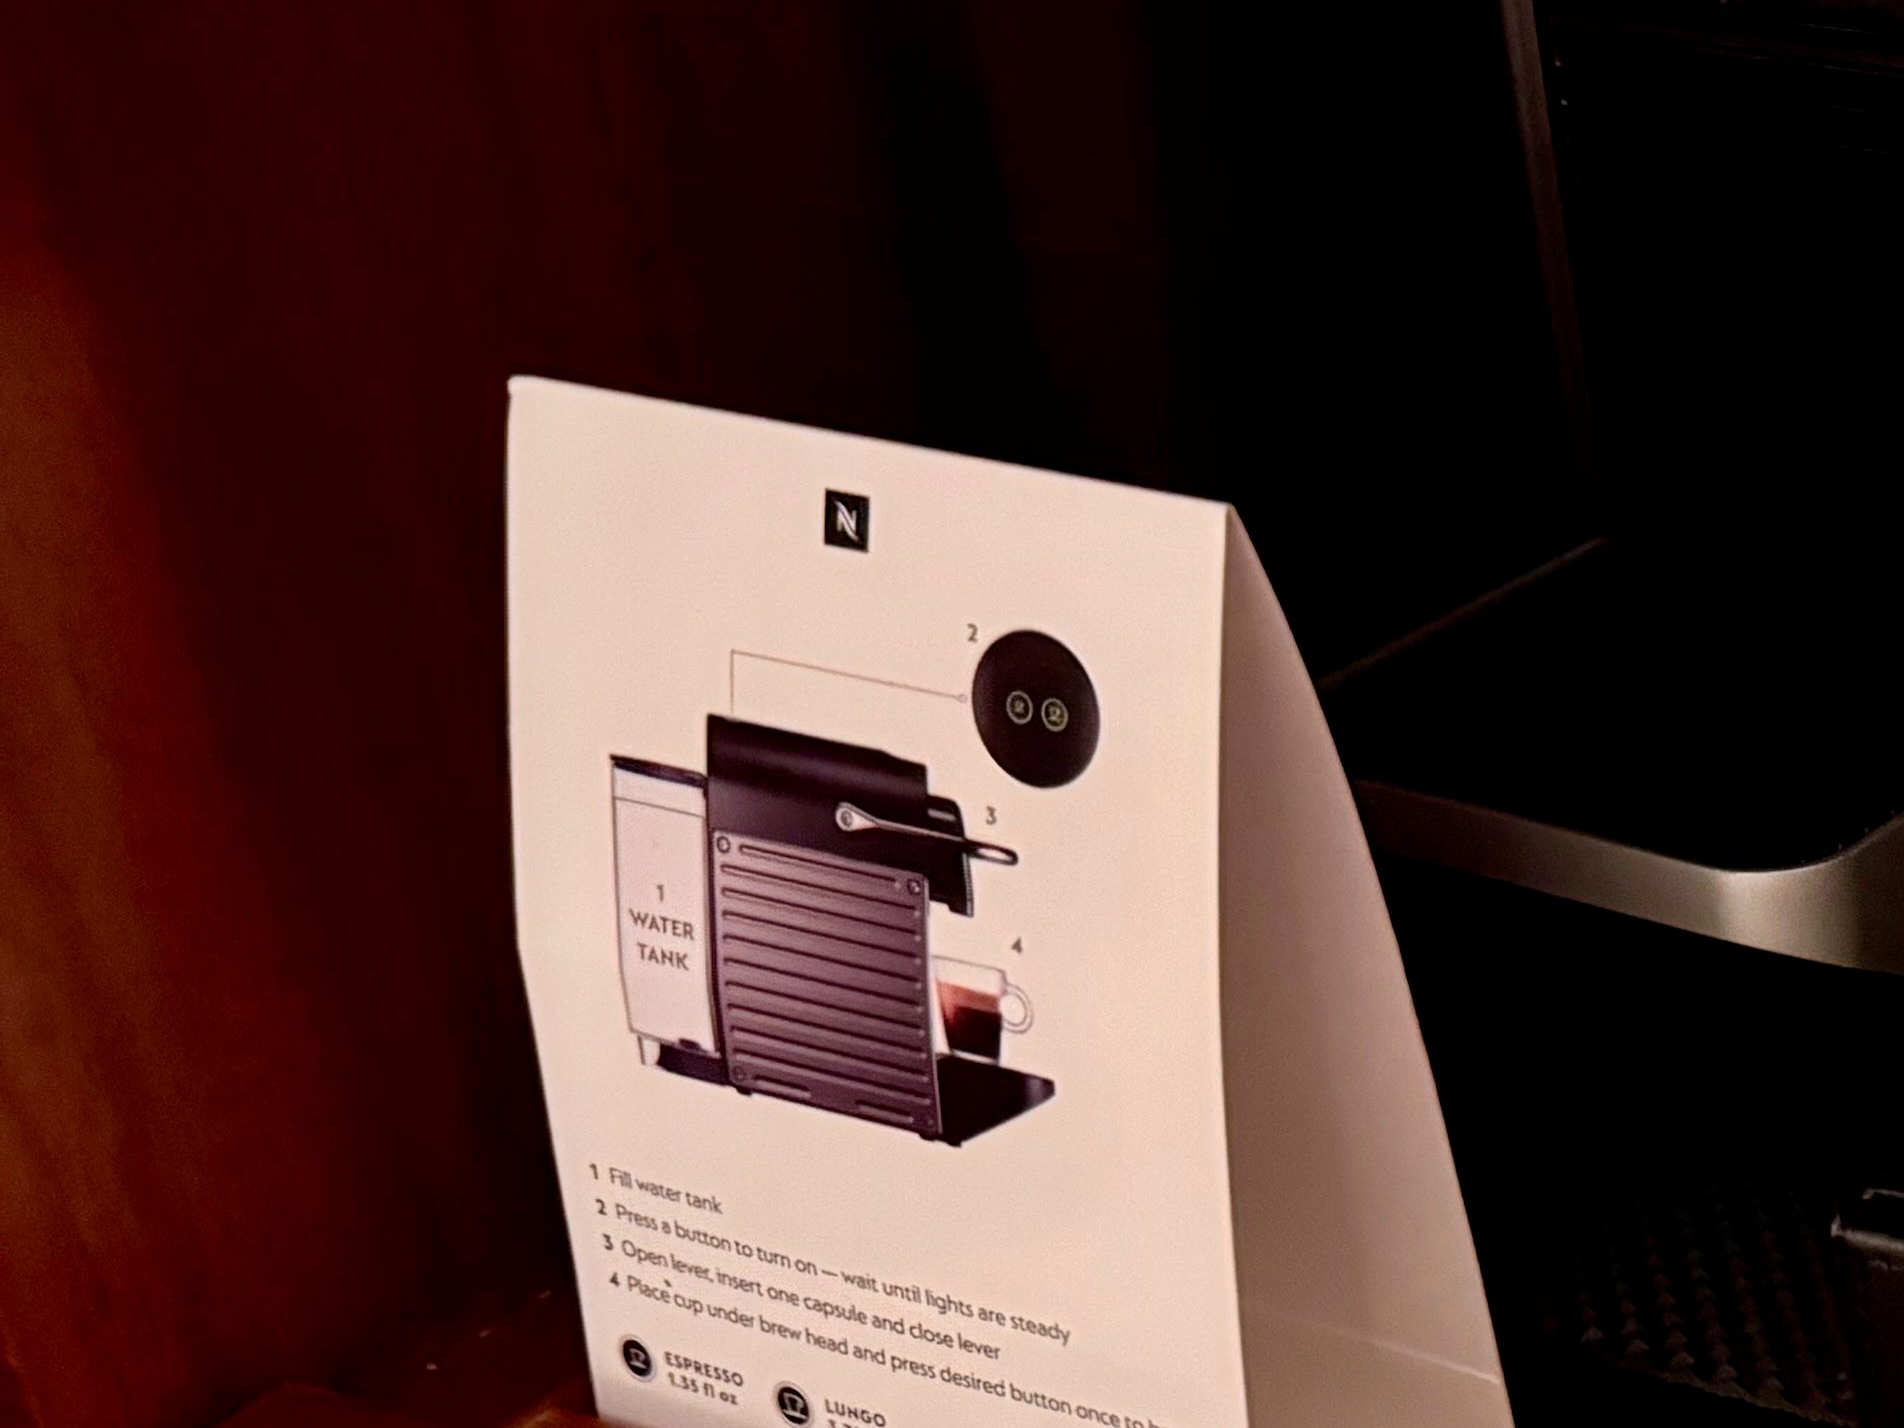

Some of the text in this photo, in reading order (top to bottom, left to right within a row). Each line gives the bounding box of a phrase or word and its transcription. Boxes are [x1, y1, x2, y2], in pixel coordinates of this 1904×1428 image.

[967, 624, 978, 643] 2
[986, 807, 996, 825] 3
[629, 909, 695, 941] WATER
[637, 942, 689, 971] TANK
[1012, 937, 1022, 953] 4
[589, 1163, 723, 1214] 1 Fill water tank
[596, 1199, 1070, 1346] 2 Press a button to turn on wait until lights are steady
[602, 1234, 1000, 1359] 3 Open lever, insert one capsule and close lever
[610, 1273, 620, 1286] 4
[628, 1275, 670, 1303] Place
[674, 1294, 703, 1315] cup
[707, 1305, 755, 1328] under
[759, 1316, 801, 1341] brew
[805, 1328, 848, 1355] head
[853, 1344, 886, 1365] and
[890, 1355, 936, 1379] press
[940, 1367, 1005, 1397] desired
[1010, 1384, 1072, 1415] button
[1076, 1404, 1120, 1428] once
[665, 1351, 744, 1387] ESPRESSO
[668, 1372, 738, 1405] 1.35 fl oz
[825, 1399, 886, 1427] LUNGO
